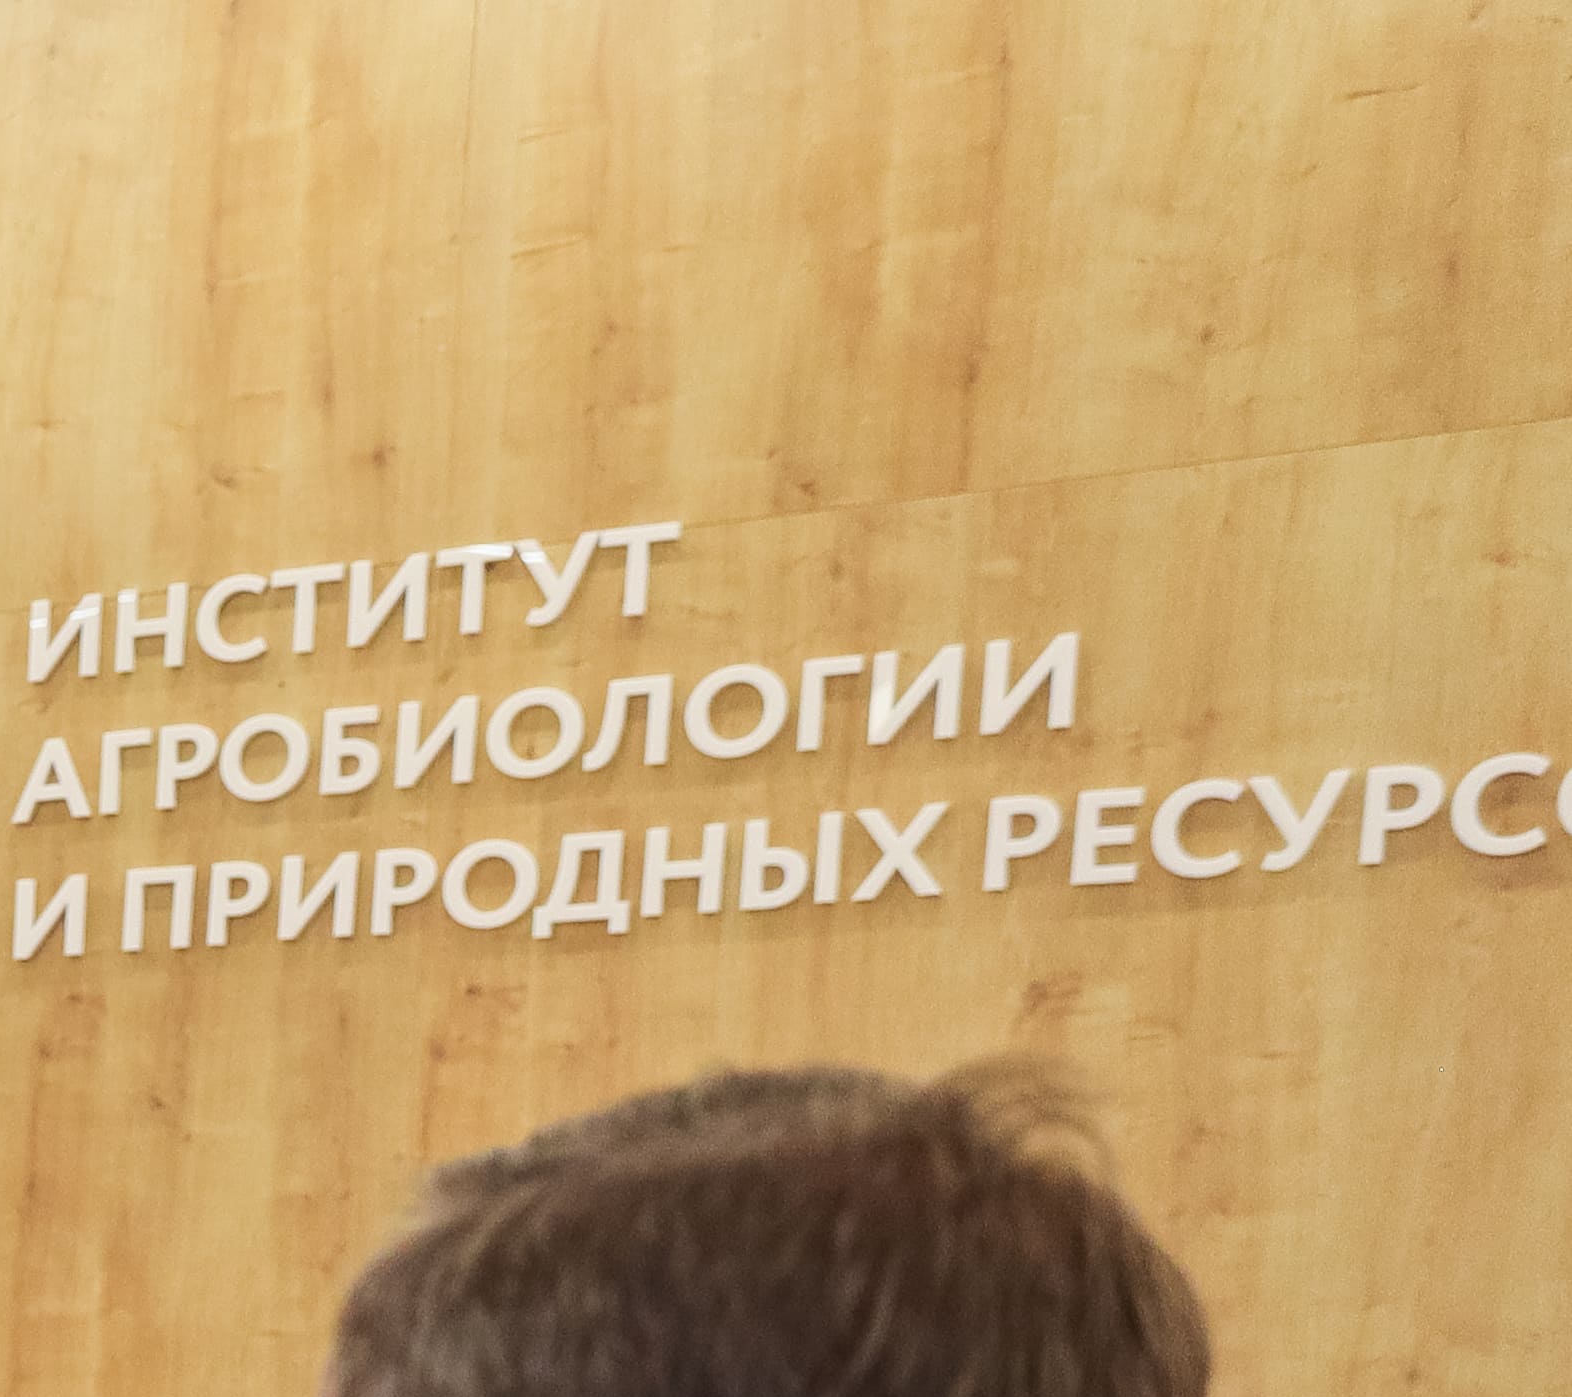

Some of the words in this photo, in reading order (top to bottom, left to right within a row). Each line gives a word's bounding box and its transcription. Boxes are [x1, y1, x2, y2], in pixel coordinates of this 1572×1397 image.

[26, 521, 683, 684] ИНСТИТУТ
[11, 630, 1080, 825] АГРОБИОЛОГИИ
[11, 873, 89, 961] И
[120, 802, 949, 954] ПРИРОДНЫХ
[981, 751, 1572, 893] РЕСУРС
